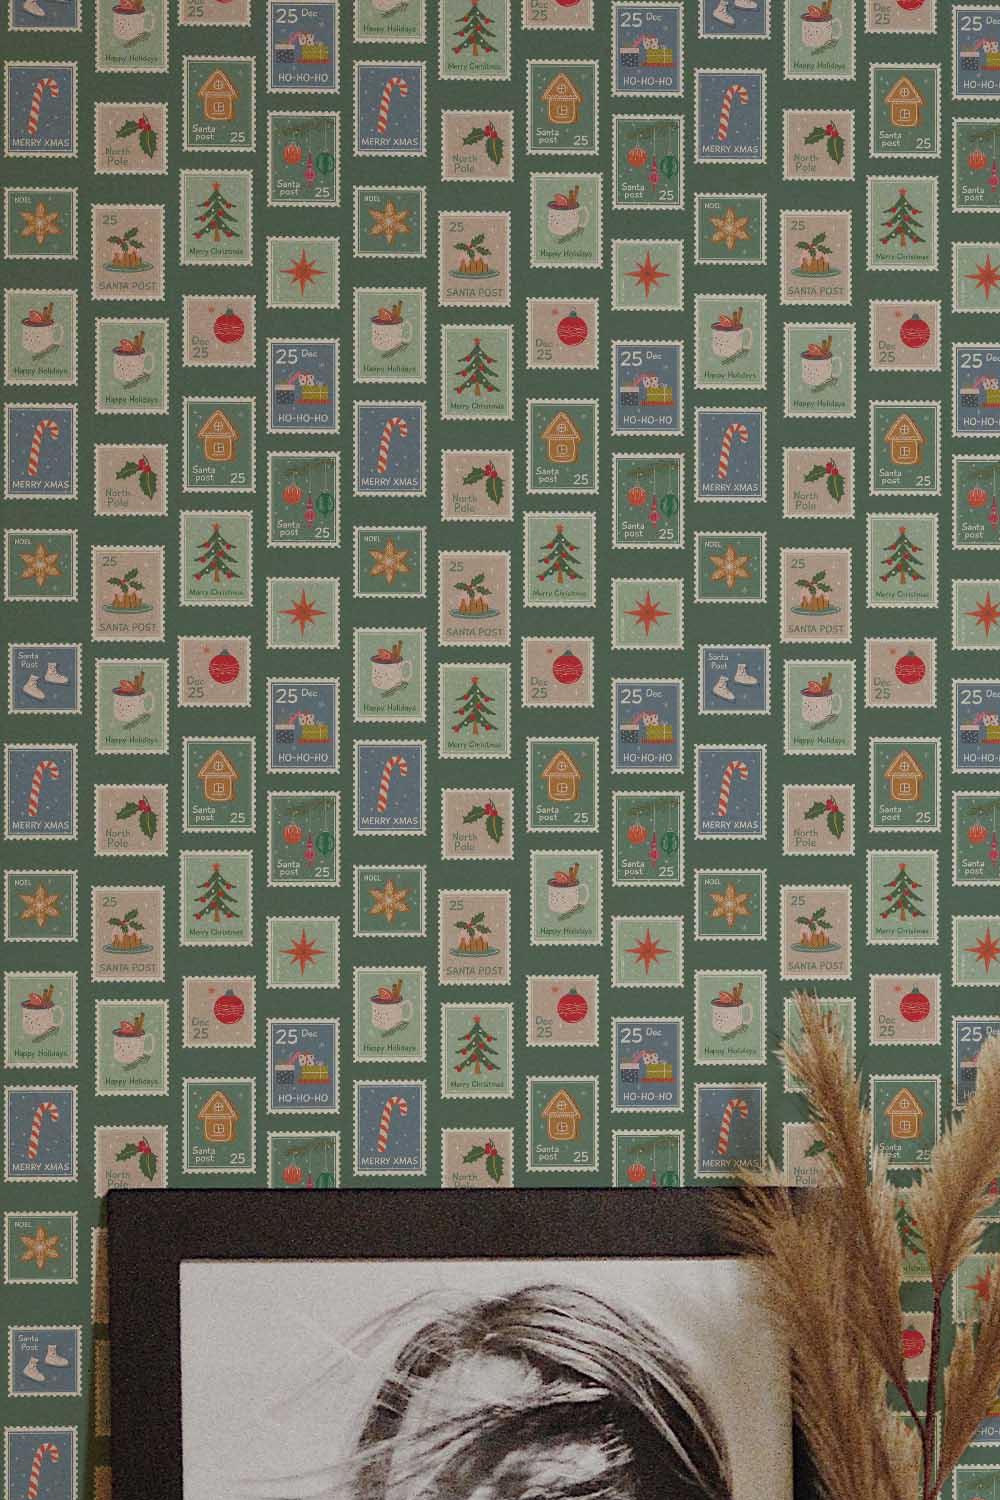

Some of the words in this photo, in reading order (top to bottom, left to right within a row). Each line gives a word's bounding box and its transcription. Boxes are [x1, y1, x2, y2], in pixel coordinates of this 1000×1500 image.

[275, 8, 298, 24] 25
[619, 11, 643, 28] 25
[959, 15, 983, 32] 25
[278, 73, 329, 82] HO-HO-HO
[622, 76, 673, 86] HO-HO-HO
[12, 138, 41, 147] MERRY
[44, 138, 70, 147] XMAS
[275, 348, 298, 364] 25
[619, 350, 643, 367] 25
[879, 350, 896, 363] 25
[959, 352, 983, 369] 25
[278, 413, 329, 422] HO-HO-HO
[622, 415, 673, 425] HO-HO-HO
[12, 480, 41, 489] MERRY
[44, 480, 70, 489] XMAS
[362, 477, 391, 487] MERRY
[393, 477, 420, 487] XMAS
[702, 483, 731, 493] MERRY
[733, 483, 760, 493] XMAS
[658, 529, 674, 540] 25
[790, 558, 806, 569] 25
[275, 688, 298, 704] 25
[619, 688, 643, 705] 25
[959, 688, 983, 705] 25
[278, 753, 329, 762] HO-HO-HO
[622, 753, 673, 763] HO-HO-HO
[230, 813, 246, 824] 25
[362, 816, 391, 826] MERRY
[393, 816, 420, 826] XMAS
[702, 820, 731, 830] MERRY
[733, 820, 760, 830] XMAS
[314, 867, 330, 878] 25
[275, 1028, 298, 1044] 25
[619, 1027, 643, 1044] 25
[278, 1093, 329, 1102] HO-HO-HO
[622, 1092, 673, 1102] HO-HO-HO
[362, 1156, 391, 1166] MERRY
[393, 1156, 420, 1166] XMAS
[573, 1152, 589, 1163] 25
[12, 1162, 41, 1171] MERRY
[44, 1162, 70, 1171] XMAS
